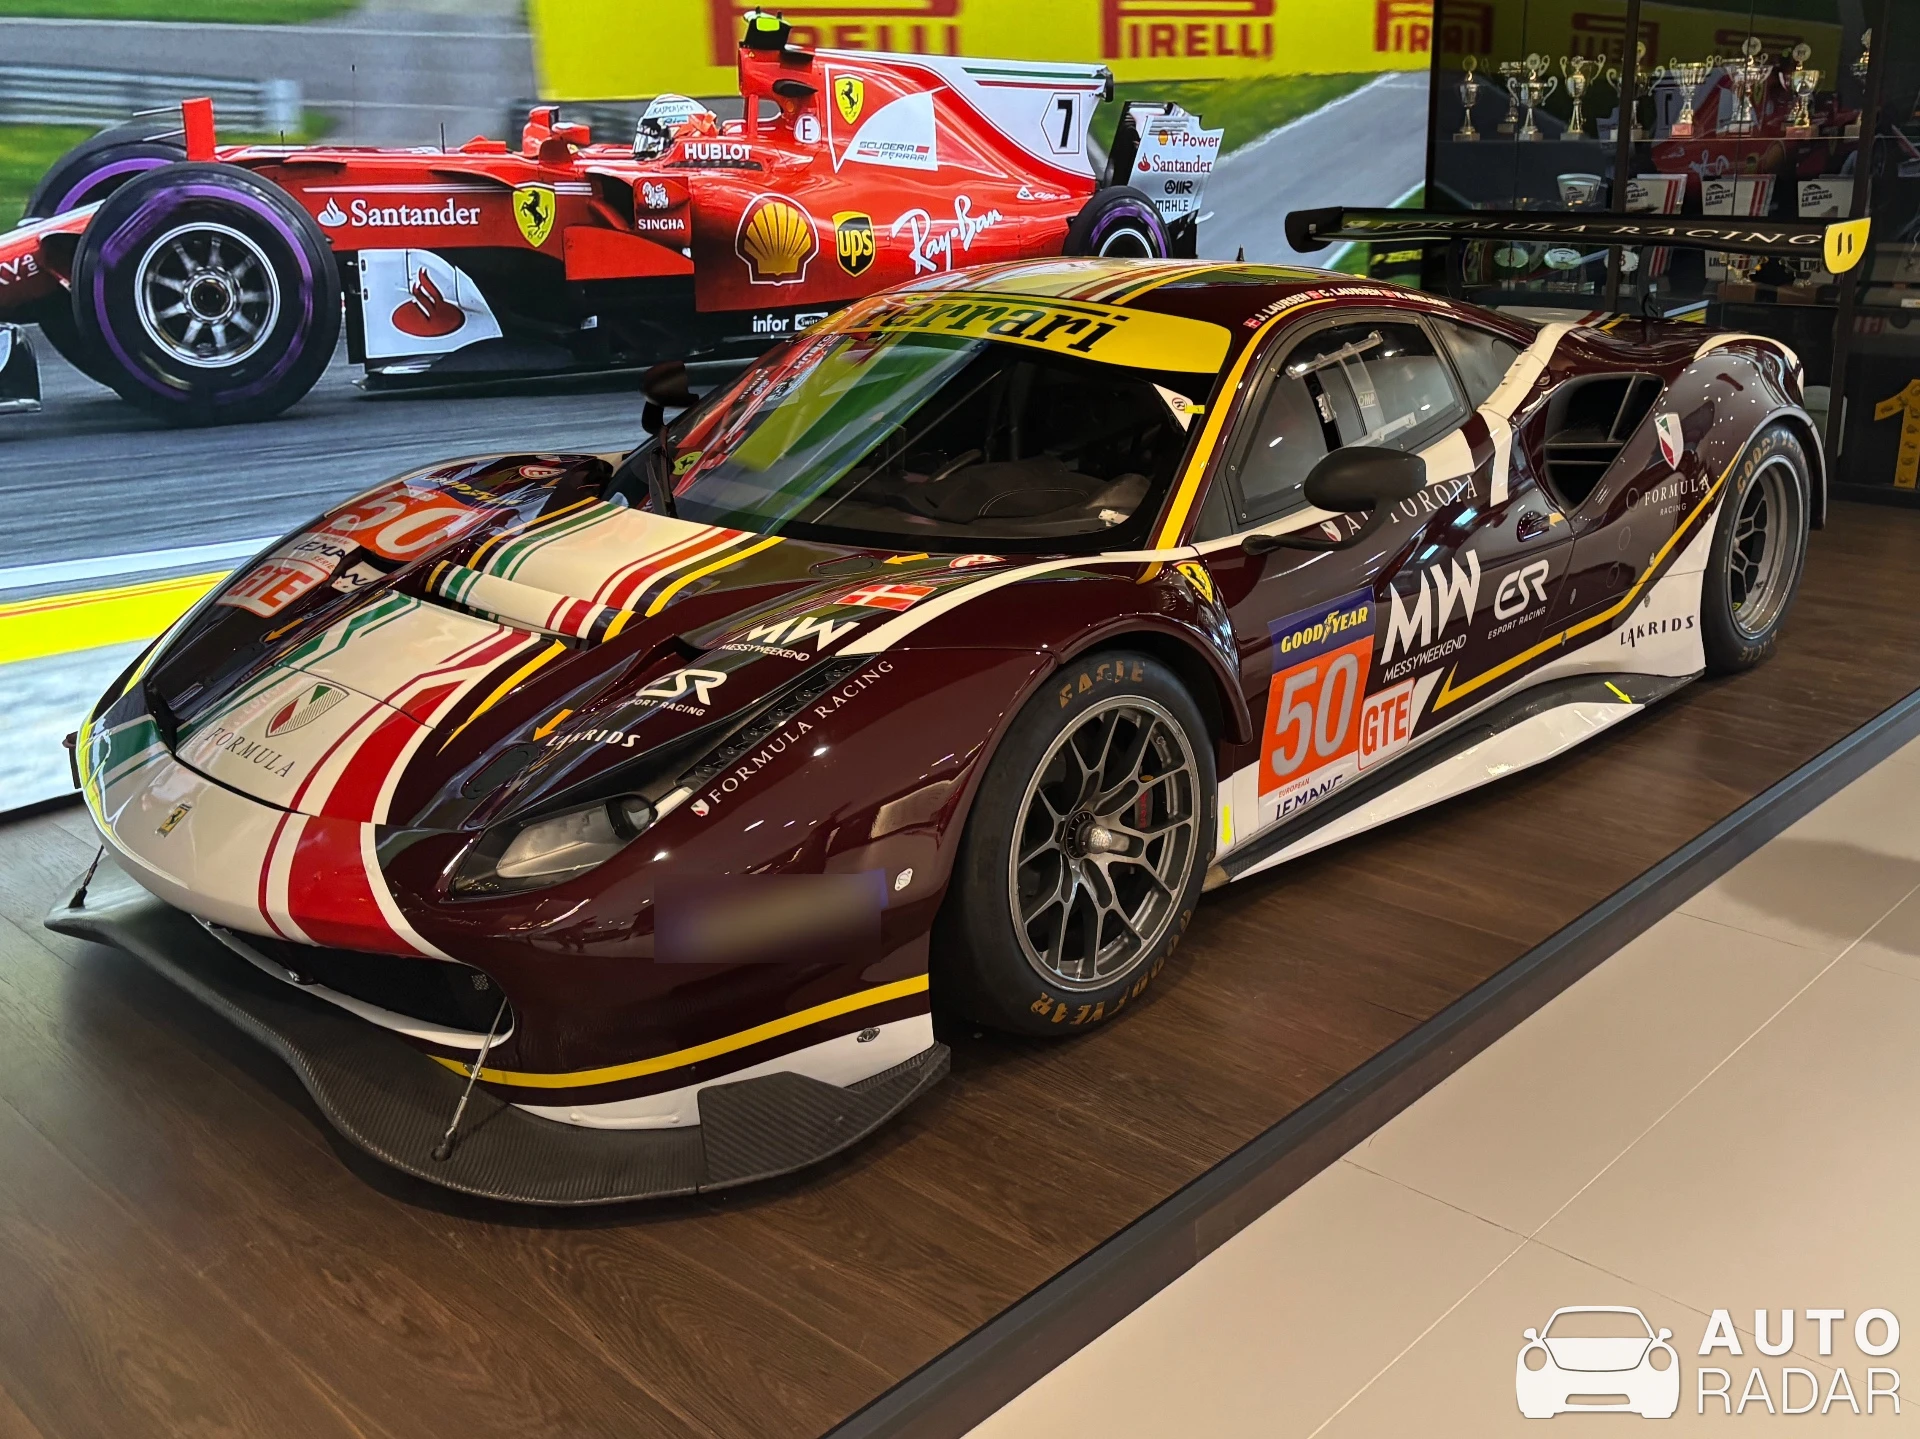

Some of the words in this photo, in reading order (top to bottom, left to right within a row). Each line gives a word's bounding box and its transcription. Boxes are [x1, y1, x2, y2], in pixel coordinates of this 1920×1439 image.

[713, 0, 961, 66] PRELLI
[1102, 0, 1274, 58] PIRELLI
[802, 118, 811, 140] E
[1057, 99, 1073, 148] 7
[684, 144, 752, 160] HUBLOT
[859, 142, 915, 153] SCUDERIA
[880, 152, 928, 162] FERRARI
[1152, 154, 1212, 173] Santander
[351, 199, 480, 227] Santander
[1155, 200, 1188, 212] MAHLE
[638, 218, 685, 230] SINGHA
[1374, 220, 1587, 233] FORMULA
[1609, 226, 1823, 245] RACING
[839, 229, 873, 267] ups
[1267, 292, 1311, 316] LAURSEN
[753, 314, 789, 332] infor
[1644, 474, 1711, 506] FORMULA
[1487, 620, 1517, 640] ESPORT
[1518, 606, 1547, 628] RACING
[1620, 615, 1695, 647] LAKRIDS
[718, 643, 811, 662] MESSYWEEKEND
[1383, 634, 1467, 683] MESSYWEEKEND
[659, 699, 706, 717] RACING
[1271, 653, 1358, 777] 50
[708, 721, 814, 803] FORMULA
[813, 658, 895, 722] RACING
[1362, 692, 1409, 756] GTE
[204, 727, 295, 778] FORMULA
[1279, 777, 1311, 798] EUROPEAN
